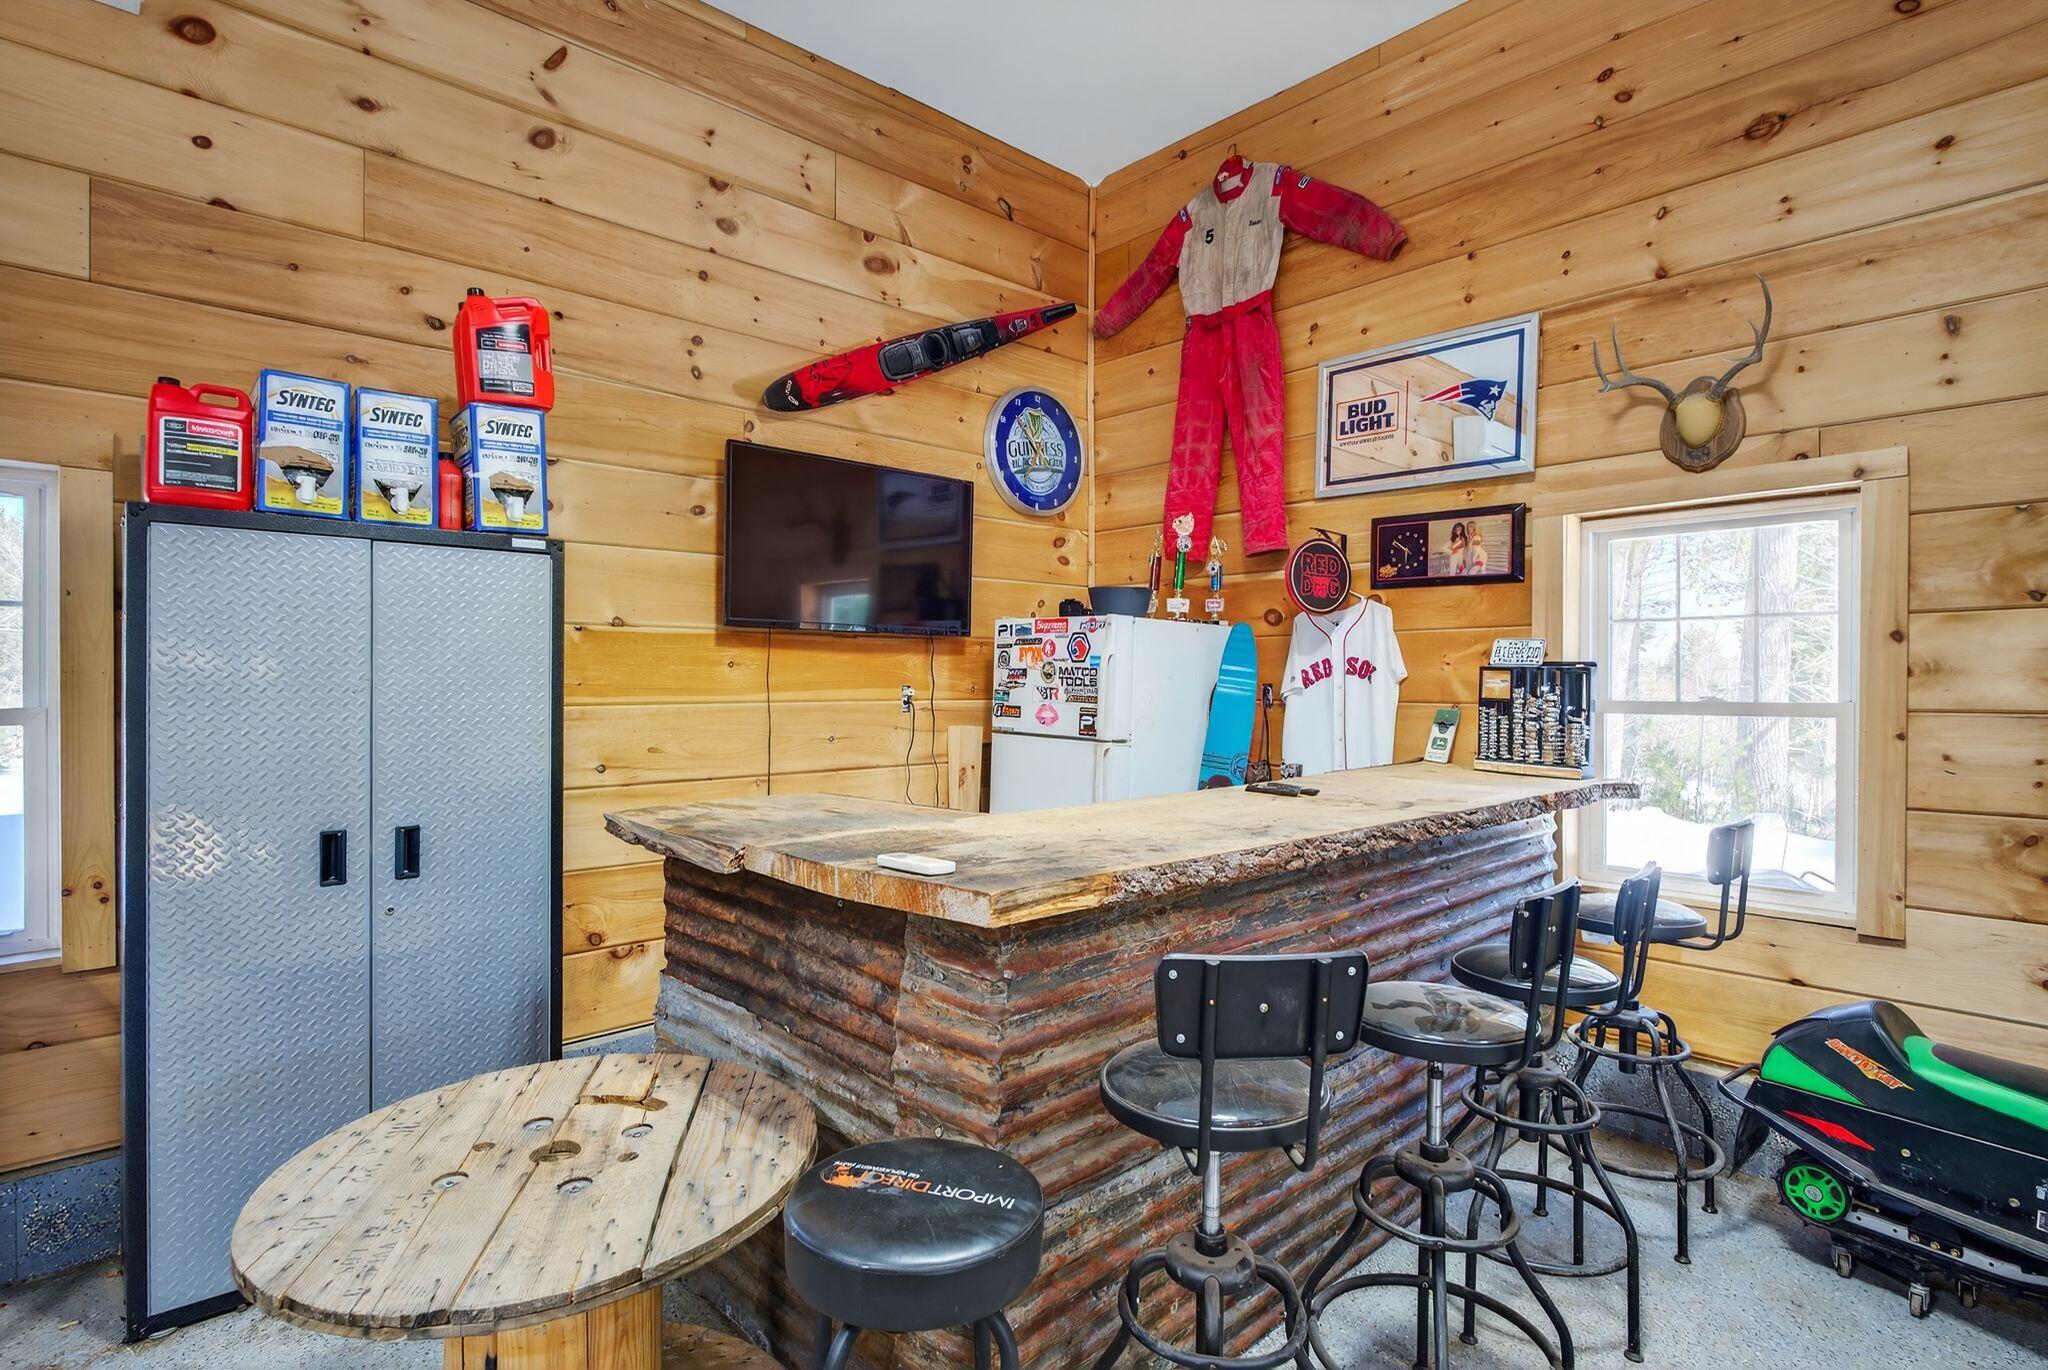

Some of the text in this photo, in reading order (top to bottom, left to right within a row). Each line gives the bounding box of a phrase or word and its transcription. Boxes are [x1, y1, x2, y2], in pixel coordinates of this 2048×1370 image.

[1205, 228, 1215, 244] 5
[276, 390, 336, 413] SYNTEC
[1347, 399, 1387, 419] BUD
[369, 407, 424, 427] SYNTEC
[1339, 412, 1395, 435] LIGHT
[485, 420, 533, 438] SYNTEC
[1008, 440, 1064, 458] GUIESS
[1301, 552, 1340, 577] RED
[1301, 575, 1340, 599] DG
[1058, 666, 1098, 678] MATCO
[1058, 676, 1098, 687] TOOLS
[1301, 658, 1332, 689] RED
